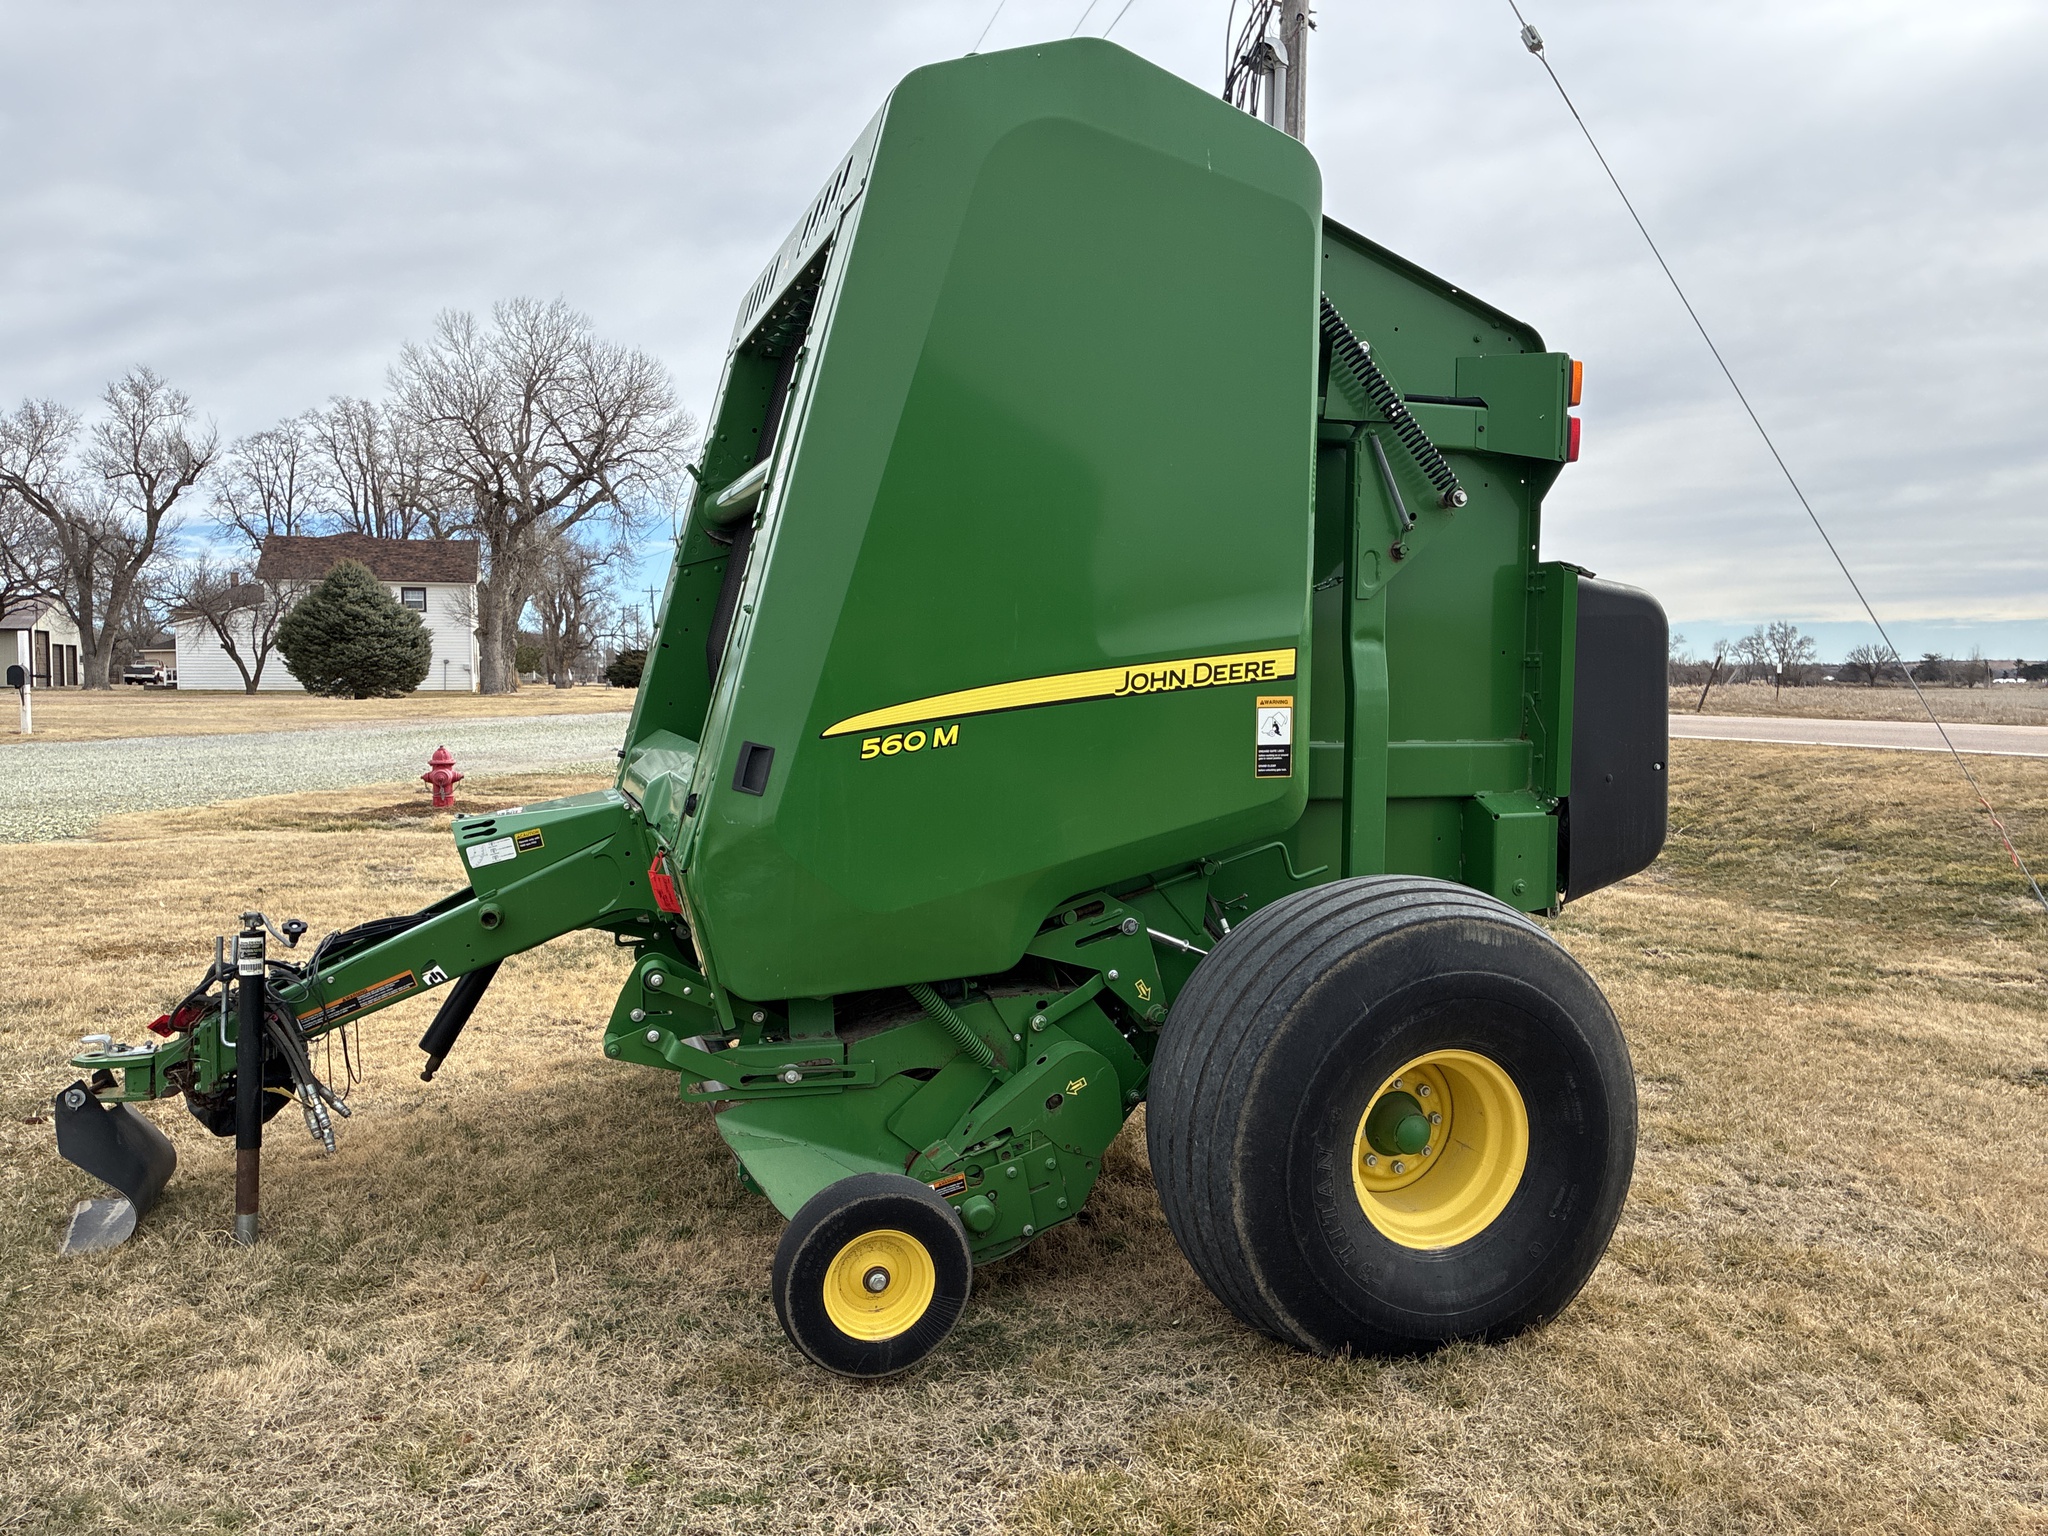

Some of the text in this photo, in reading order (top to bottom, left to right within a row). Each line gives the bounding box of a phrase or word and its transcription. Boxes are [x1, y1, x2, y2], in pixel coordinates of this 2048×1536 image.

[1115, 659, 1276, 693] JOHN DEERE
[860, 723, 961, 760] 560 M
[1316, 1149, 1357, 1267] TITAN
